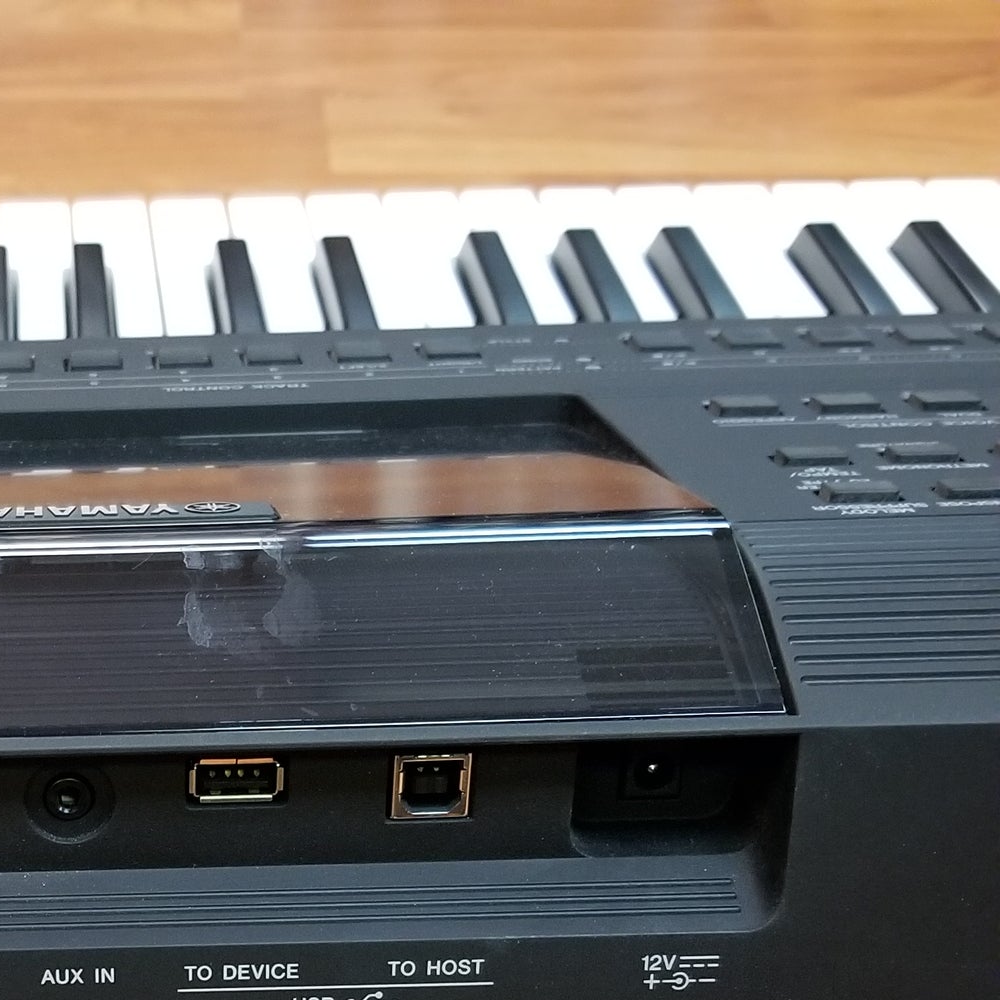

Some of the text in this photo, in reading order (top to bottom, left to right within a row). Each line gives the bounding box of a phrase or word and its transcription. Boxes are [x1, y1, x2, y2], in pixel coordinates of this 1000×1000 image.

[840, 508, 916, 516] MELODY
[387, 958, 486, 977] TO HOST
[641, 954, 677, 971] 12V
[40, 967, 115, 985] AUX IN
[184, 963, 300, 982] TO DEVICE
